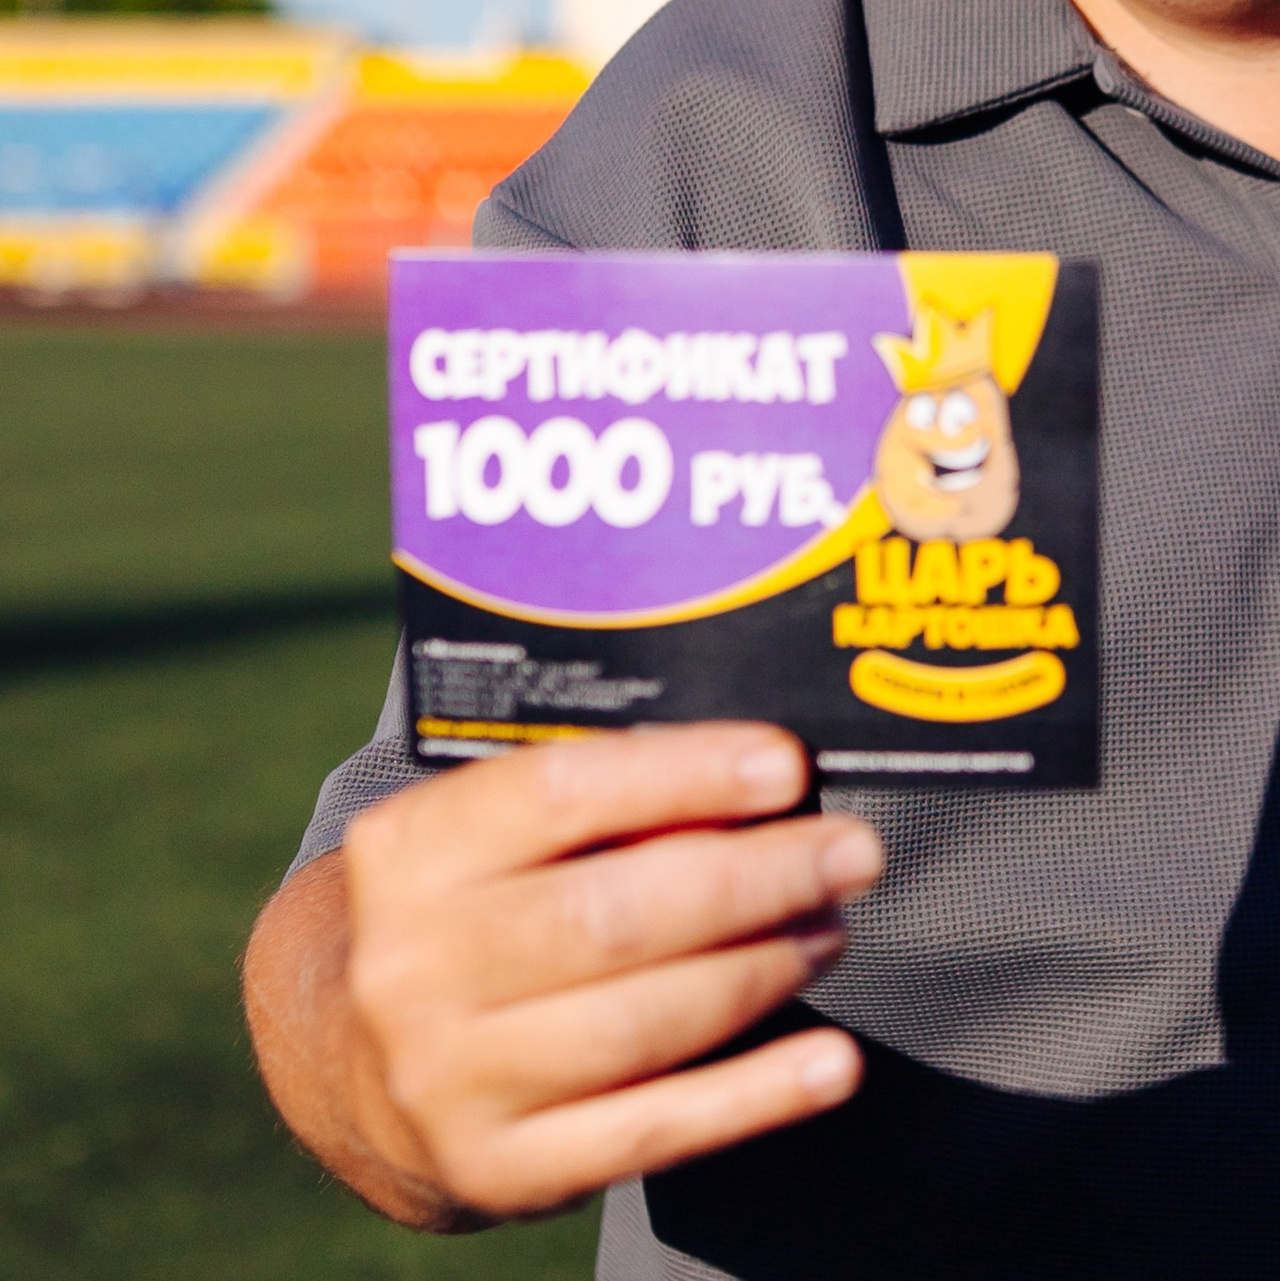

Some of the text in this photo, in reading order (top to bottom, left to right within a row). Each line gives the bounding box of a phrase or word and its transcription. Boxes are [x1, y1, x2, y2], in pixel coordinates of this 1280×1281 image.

[410, 328, 848, 406] СЕРТИФИКАТ
[414, 415, 848, 528] 1000 РУБ.
[854, 537, 1061, 606] ЦАРЬ
[833, 603, 1080, 650] КАРТОШКА
